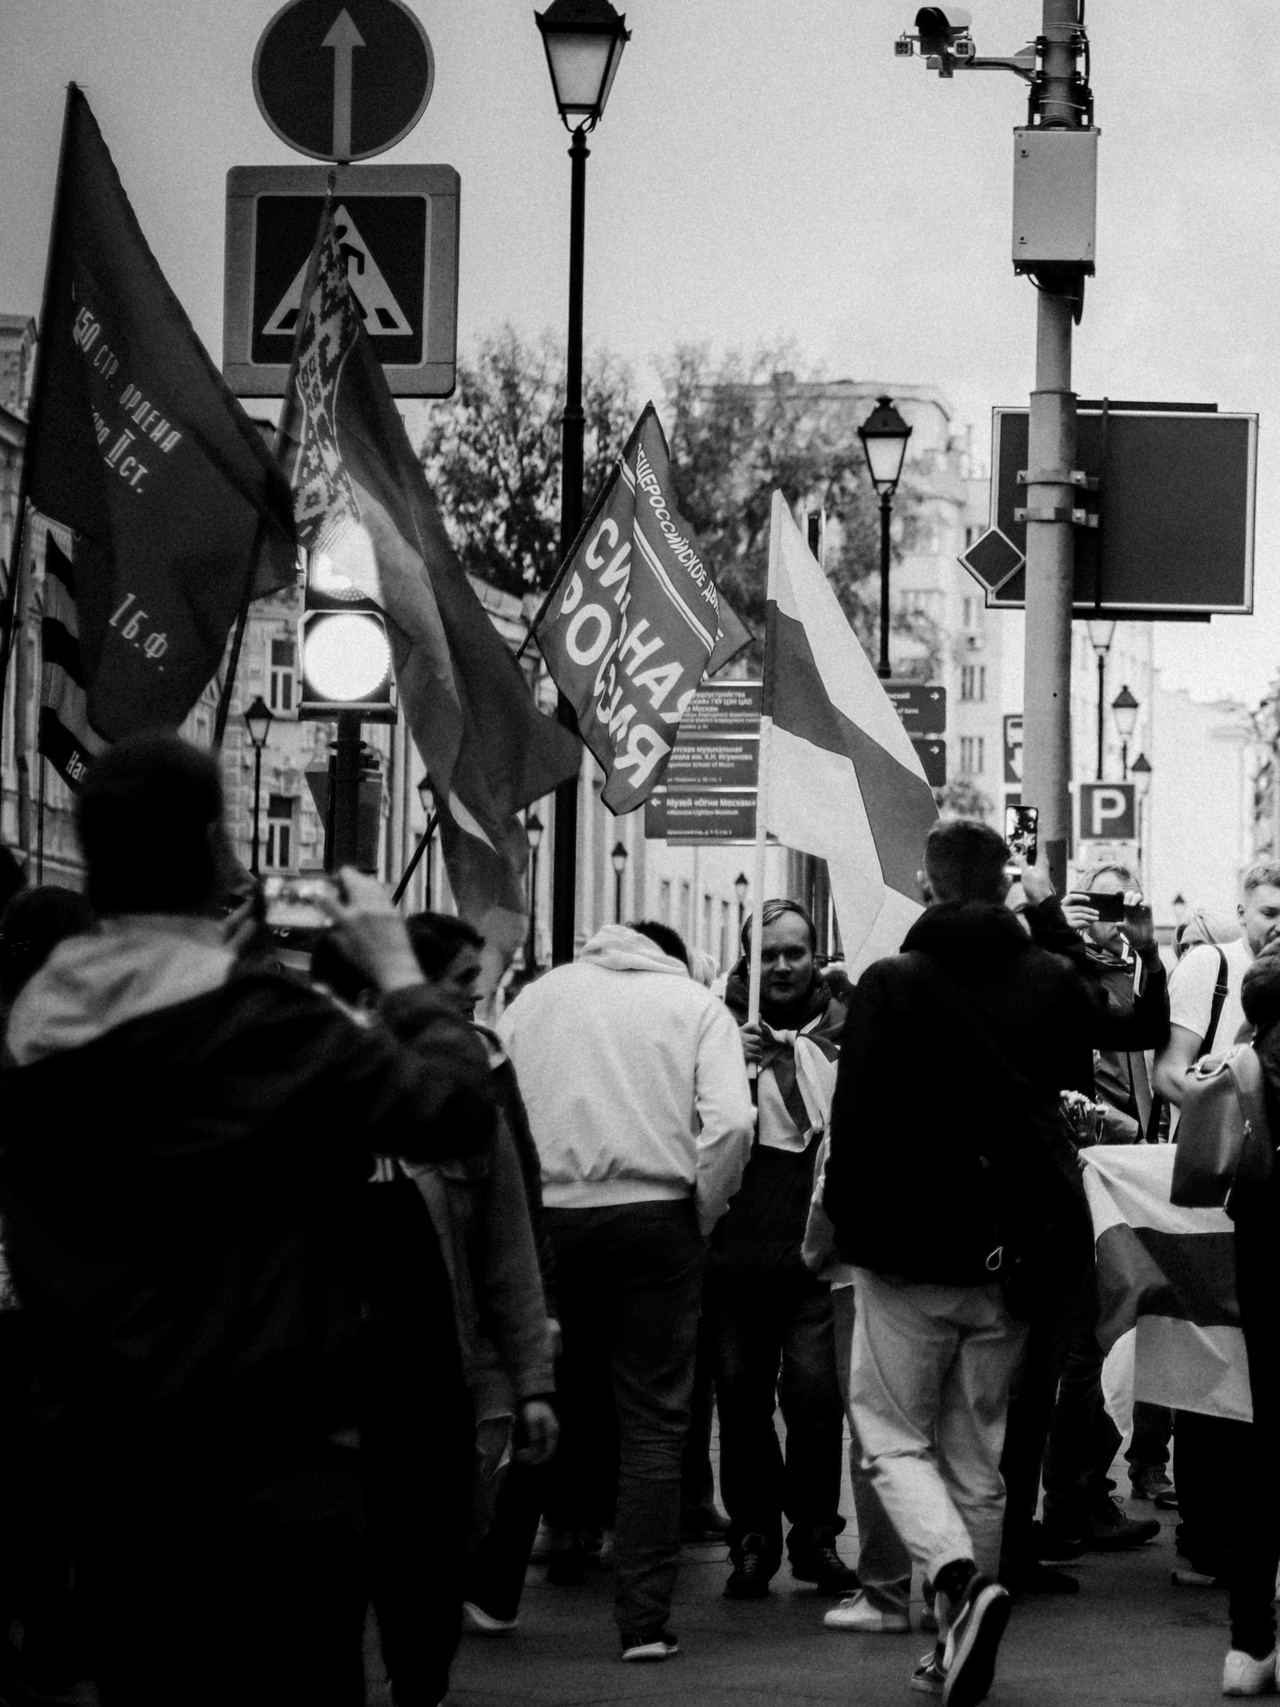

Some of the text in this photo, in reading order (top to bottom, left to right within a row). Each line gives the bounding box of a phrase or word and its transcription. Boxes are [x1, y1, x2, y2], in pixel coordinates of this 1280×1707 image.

[119, 383, 182, 453] ОРДЕНА
[666, 798, 693, 809] Музей
[1092, 788, 1126, 835] P
